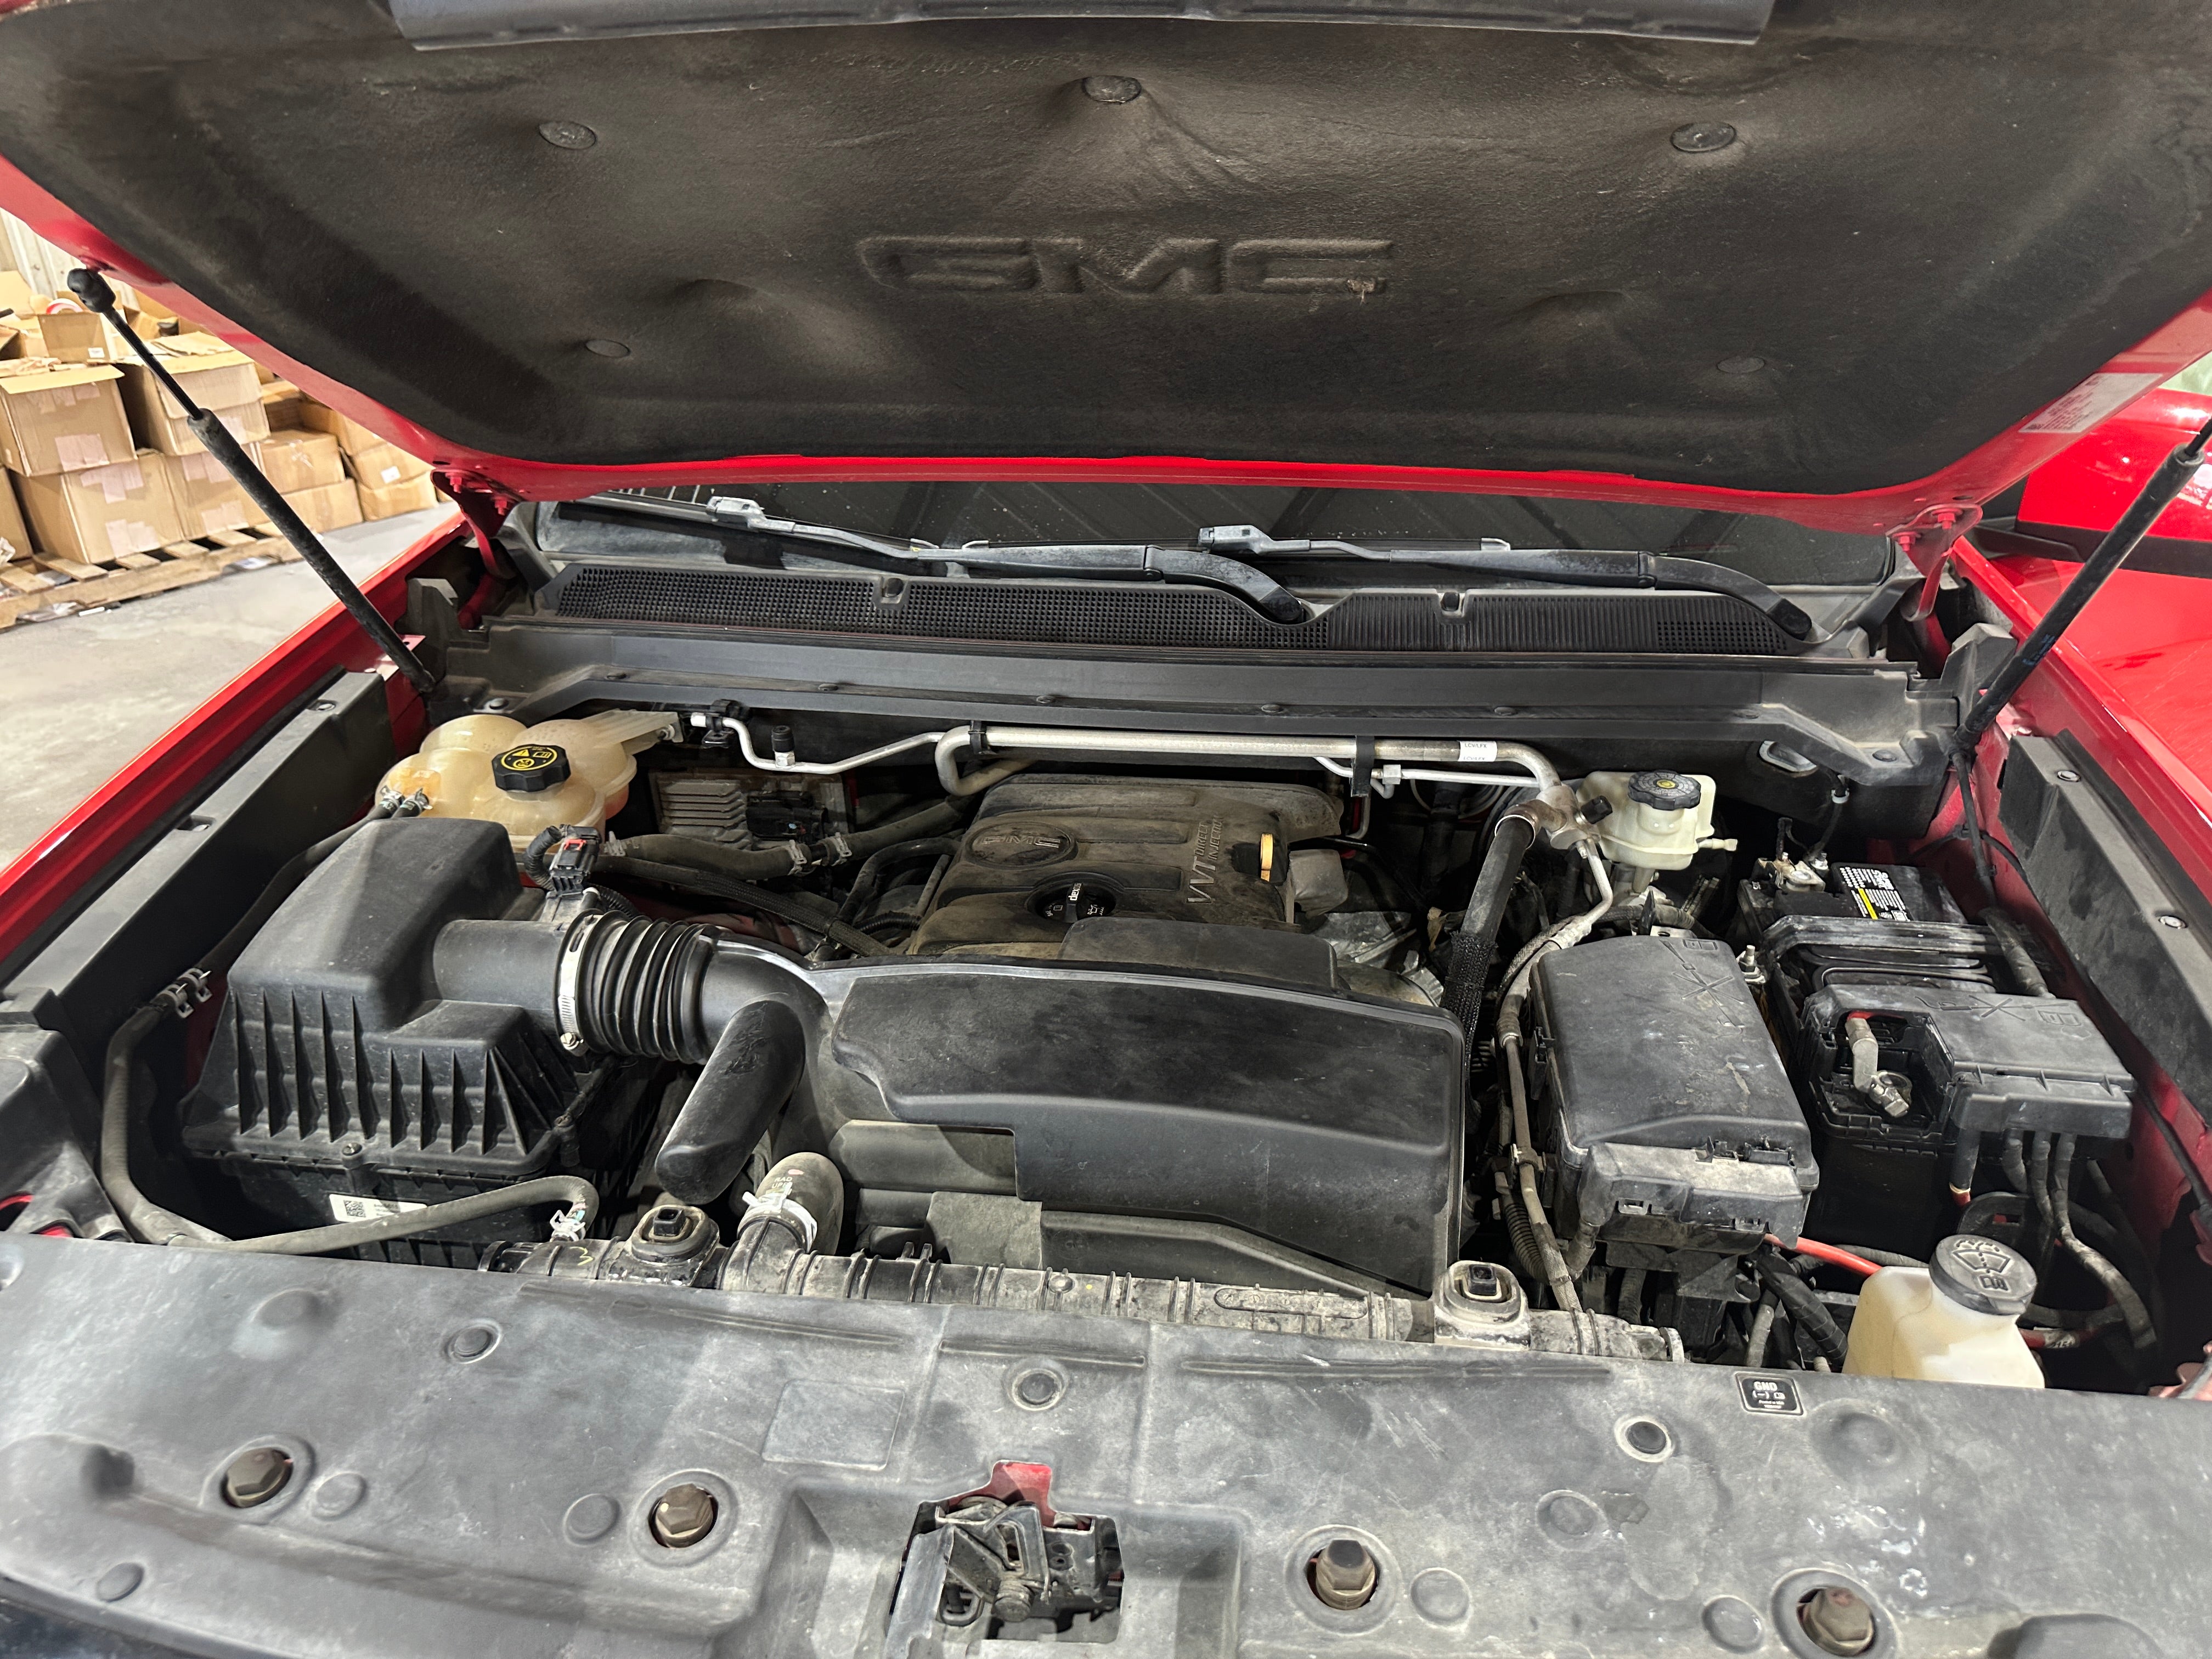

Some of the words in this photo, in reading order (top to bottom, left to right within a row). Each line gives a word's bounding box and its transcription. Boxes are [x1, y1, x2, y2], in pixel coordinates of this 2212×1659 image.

[857, 235, 1393, 297] GMC
[982, 835, 1061, 849] GMC
[1193, 821, 1208, 856] DIRECT
[1186, 856, 1216, 904] VVT
[1754, 1381, 1778, 1391] GND
